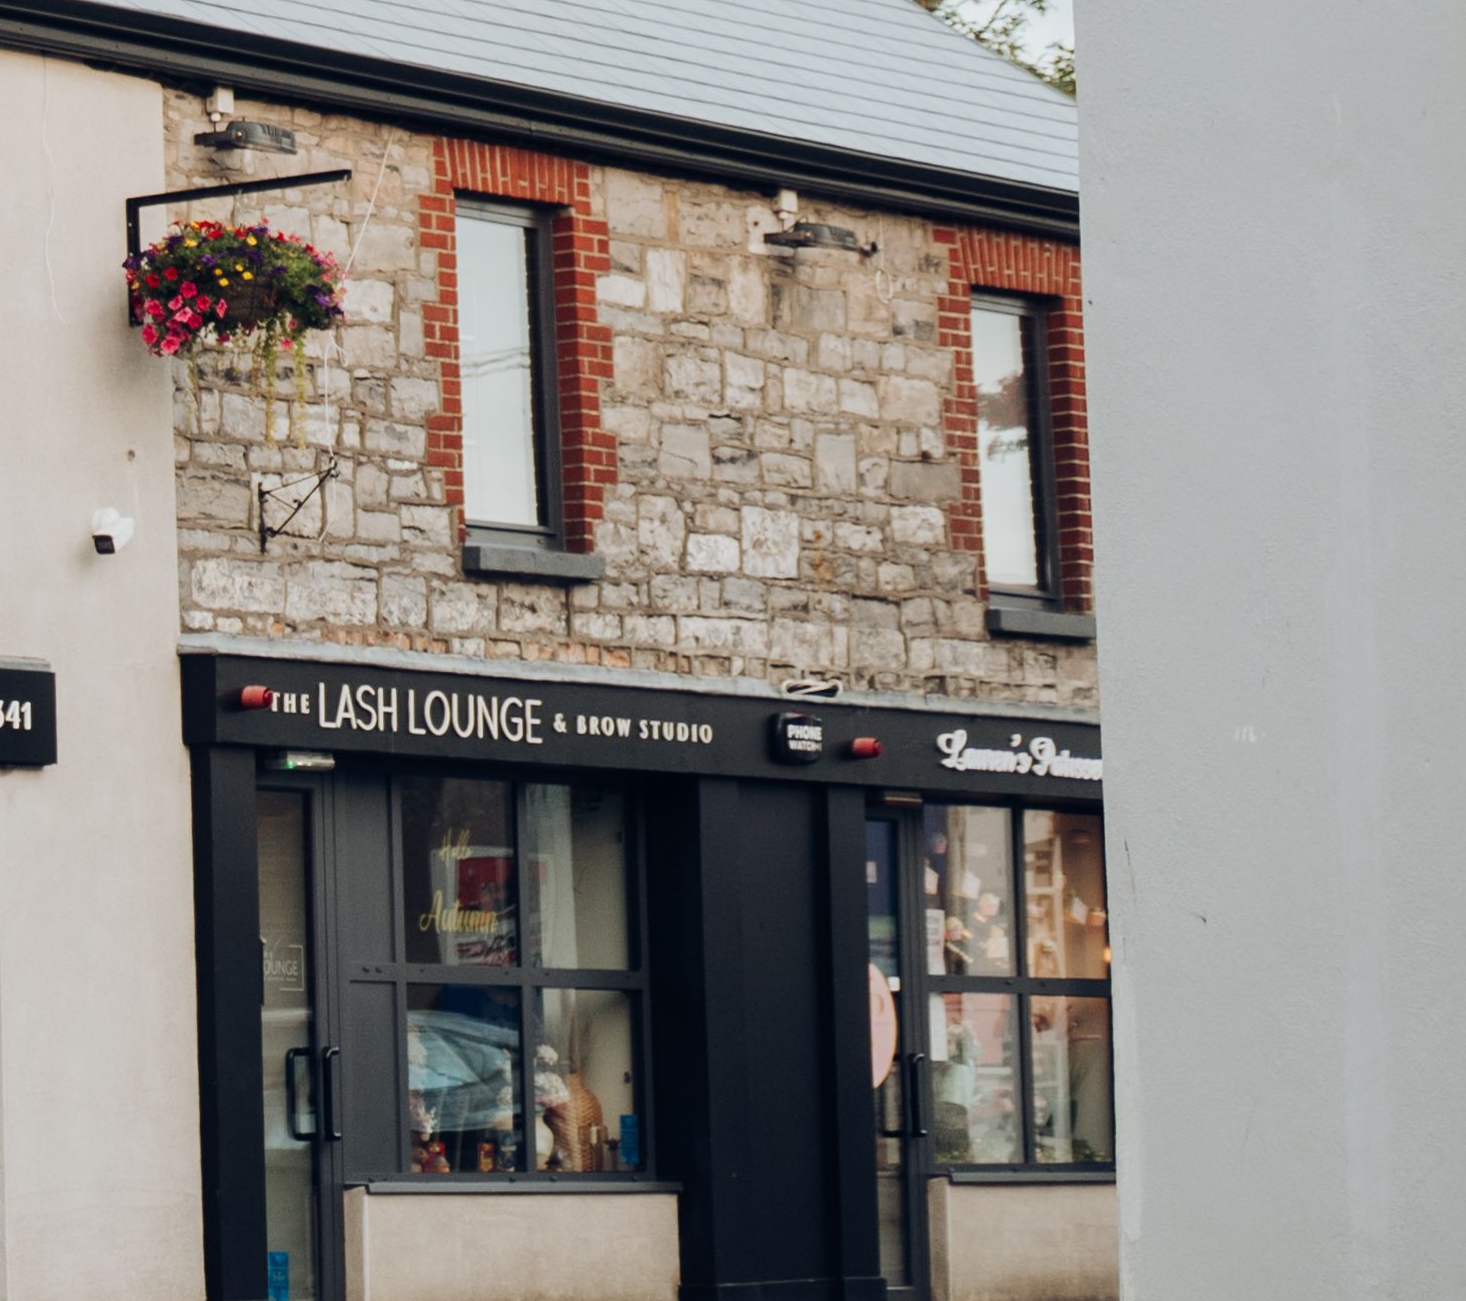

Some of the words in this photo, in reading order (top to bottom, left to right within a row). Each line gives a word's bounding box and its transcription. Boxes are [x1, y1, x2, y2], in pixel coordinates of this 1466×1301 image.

[271, 691, 310, 715] THE
[318, 681, 398, 733] LASH
[408, 688, 544, 744] LOUNGE
[553, 712, 568, 734] &
[576, 714, 632, 738] BROW
[639, 719, 714, 744] STUDIO
[787, 724, 822, 741] PHONE
[419, 890, 500, 934] Autumn
[263, 960, 299, 977] OUNGE
